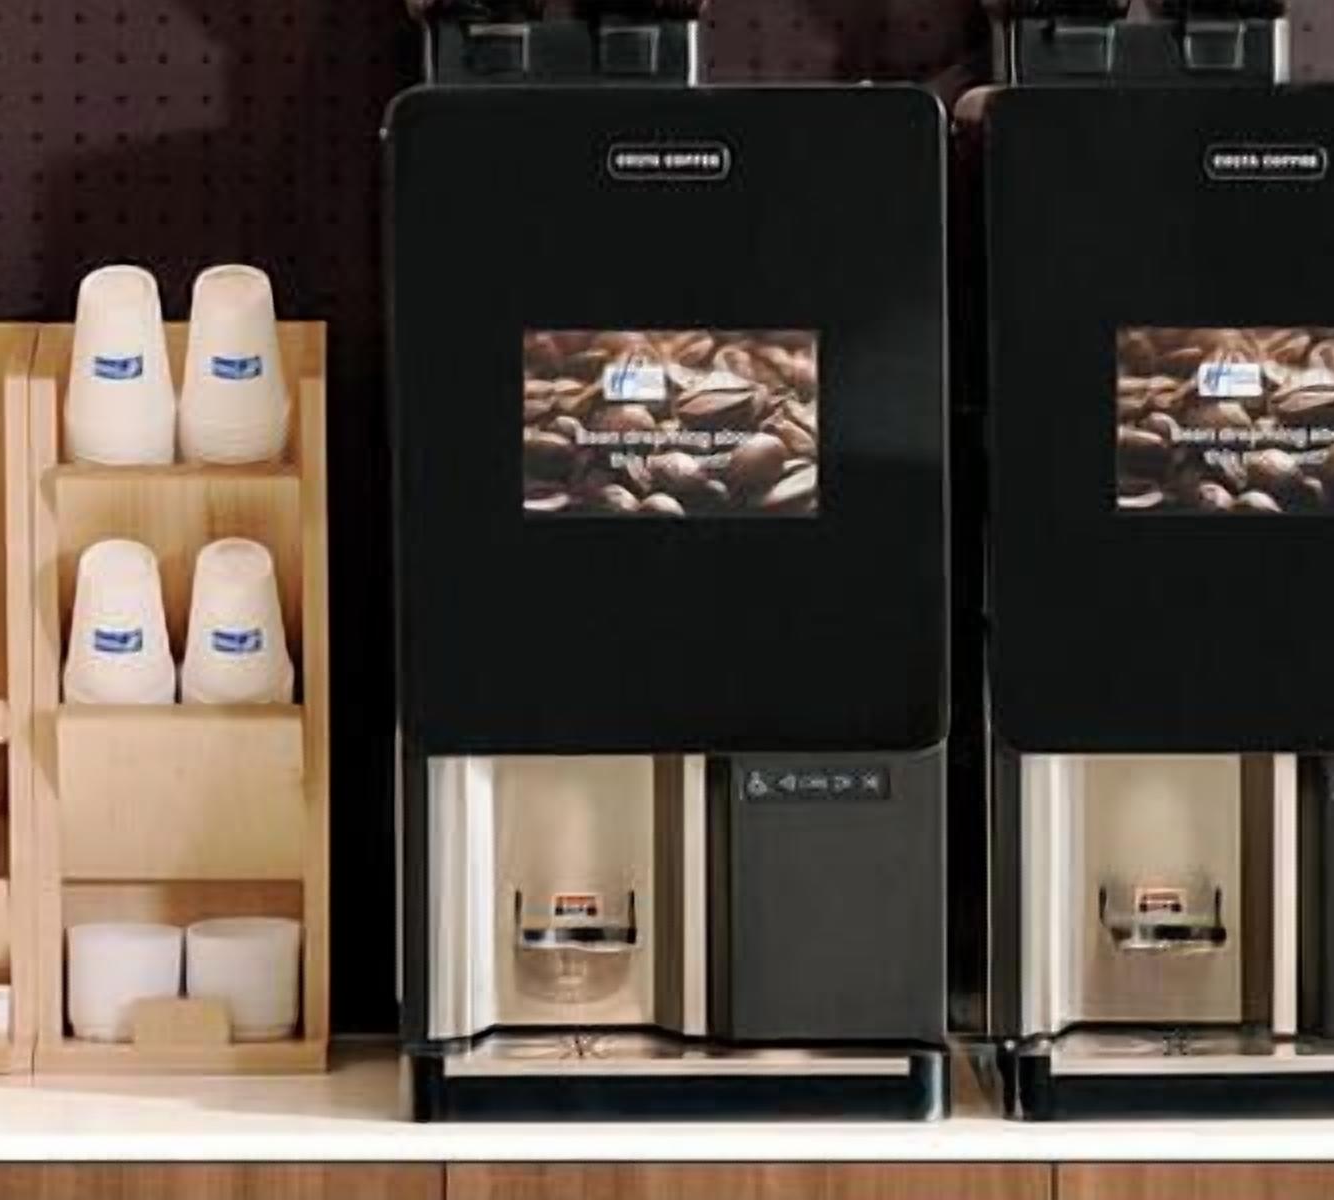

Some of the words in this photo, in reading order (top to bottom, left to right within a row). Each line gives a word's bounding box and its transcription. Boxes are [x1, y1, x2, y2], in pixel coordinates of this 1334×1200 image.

[615, 153, 660, 168] COSTA
[664, 153, 720, 168] COFFEE
[1213, 154, 1259, 168] COSTA
[1262, 154, 1317, 168] COFFEE
